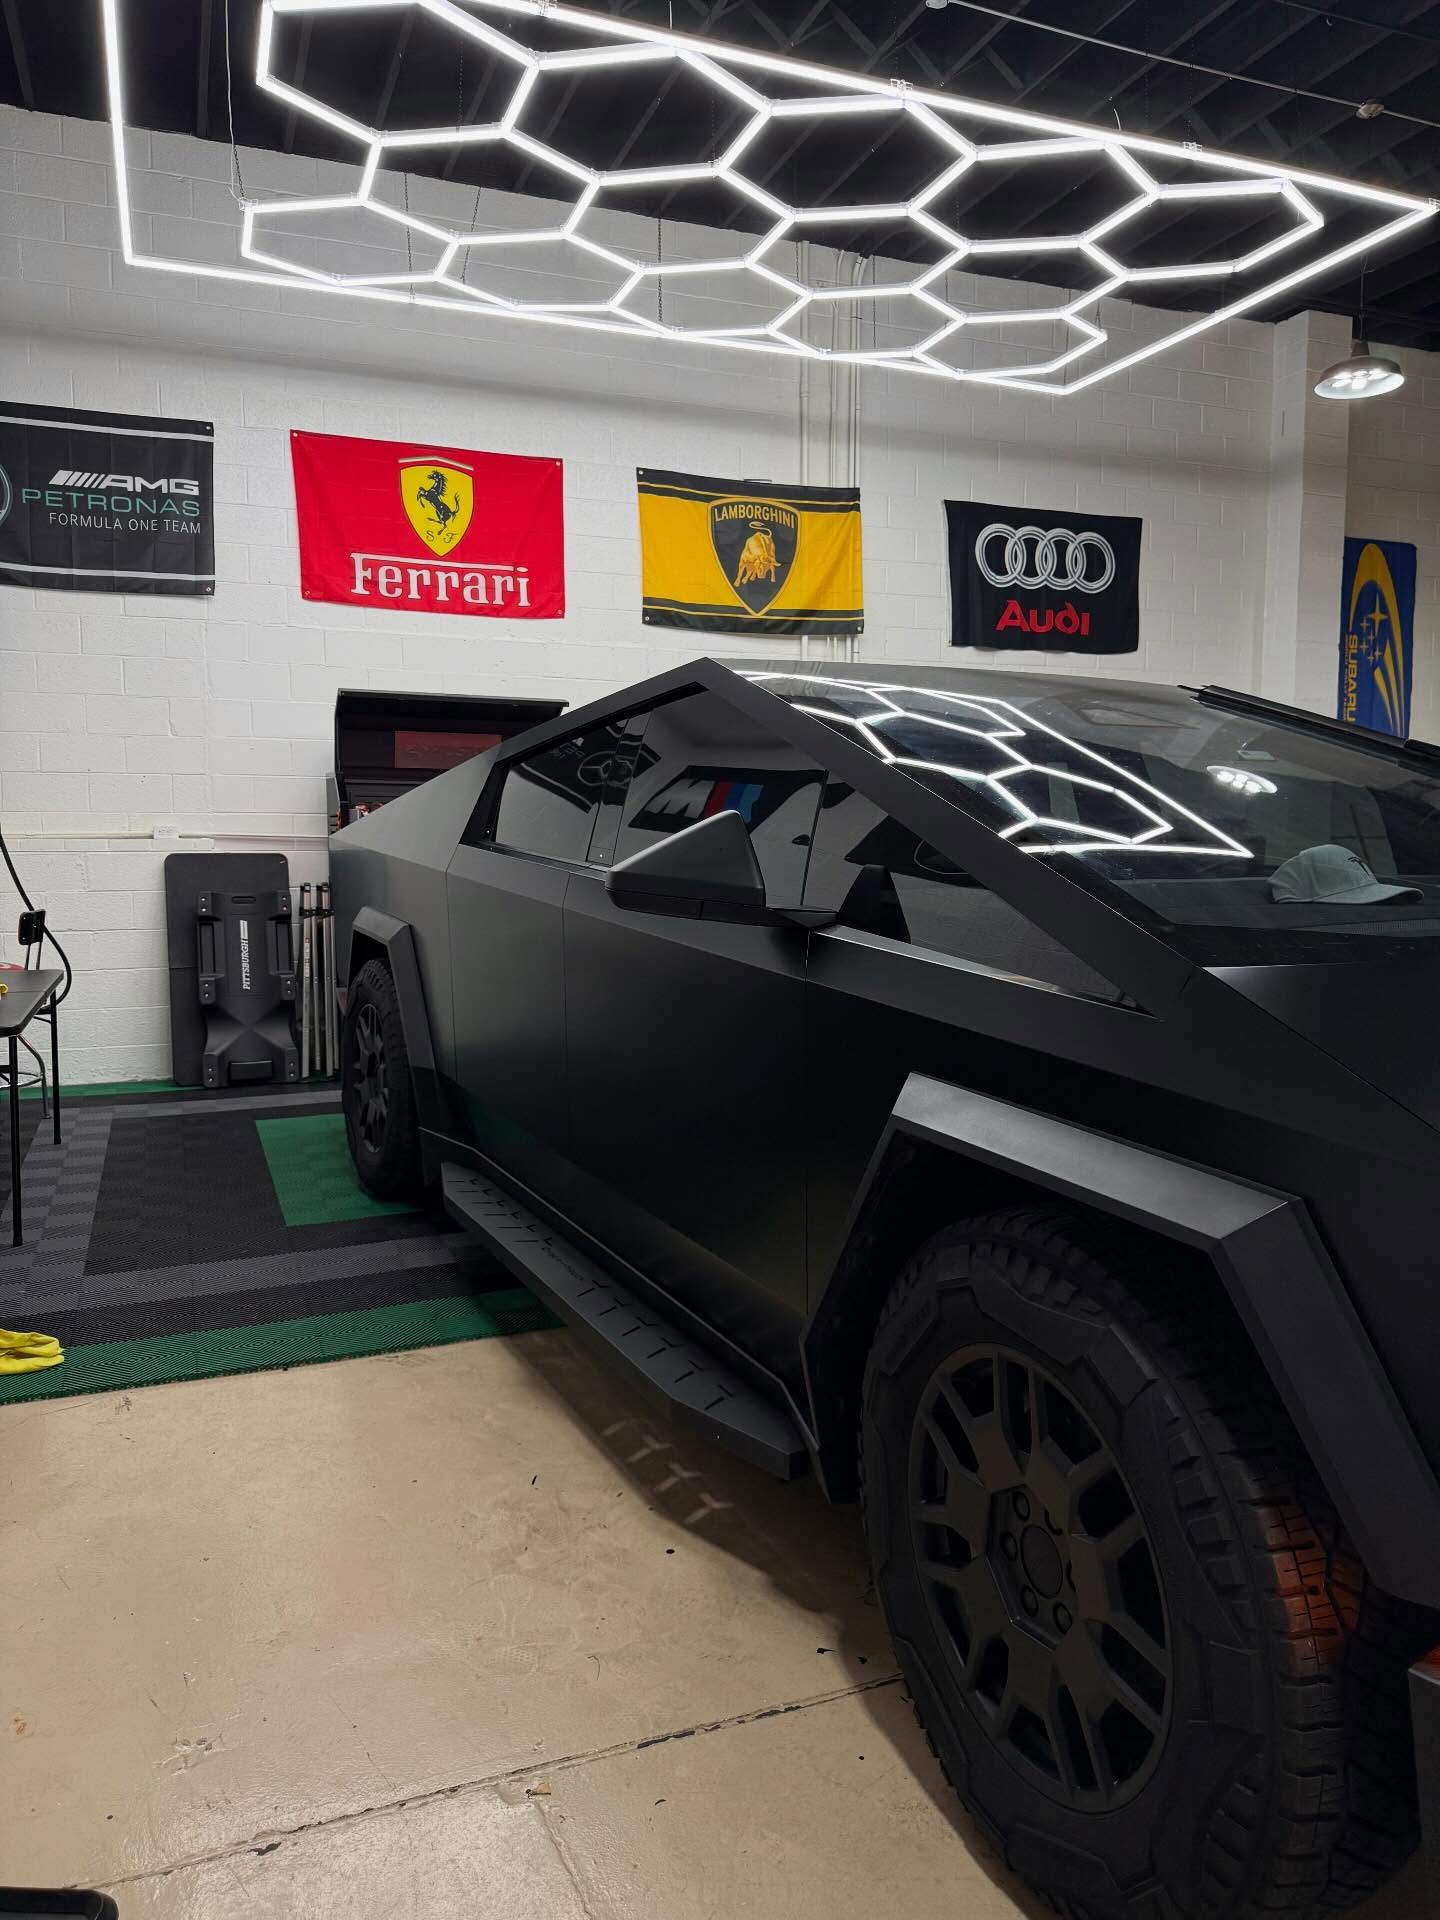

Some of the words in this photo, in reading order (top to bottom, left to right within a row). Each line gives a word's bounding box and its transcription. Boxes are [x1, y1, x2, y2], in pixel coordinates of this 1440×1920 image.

[21, 488, 200, 517] PETRONAS
[714, 503, 795, 529] LAMBORGHINI
[49, 513, 123, 530] FORMULA
[128, 518, 159, 531] ONE
[164, 519, 201, 534] TEAM
[349, 553, 531, 607] Ferrari
[996, 599, 1090, 636] Audi
[1347, 634, 1358, 722] SUBARU
[240, 938, 251, 991] PITTSBURGH
